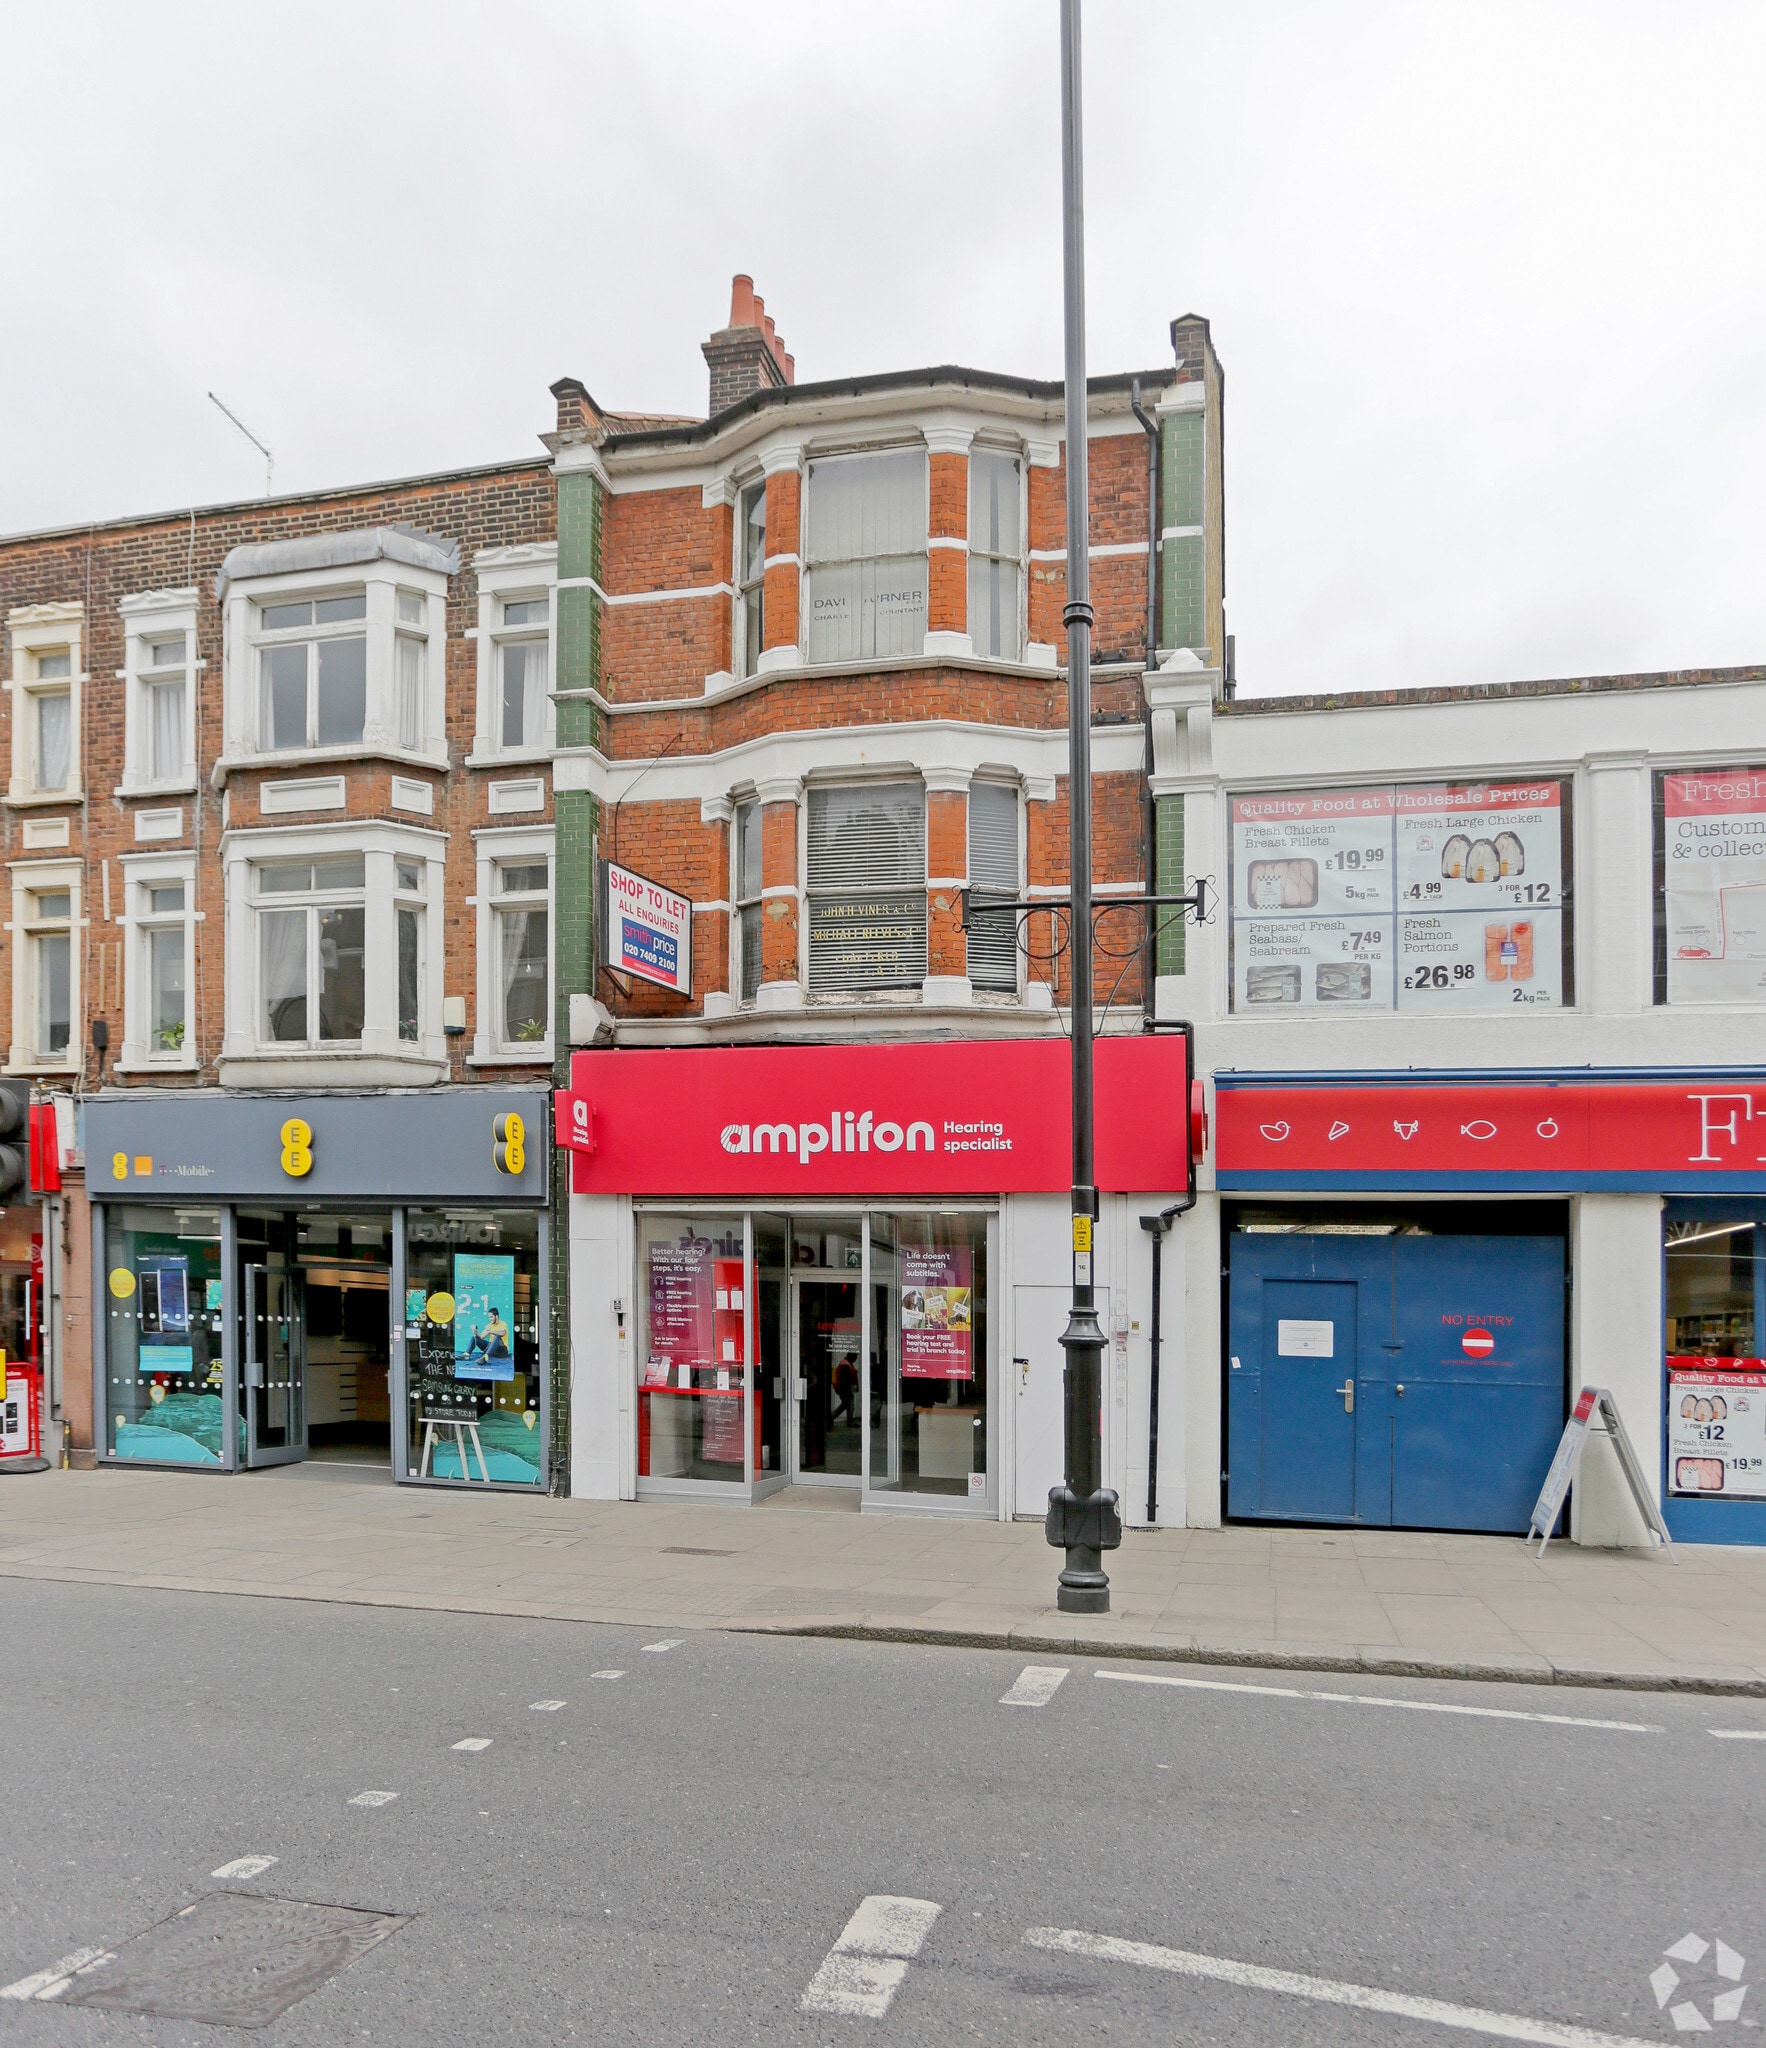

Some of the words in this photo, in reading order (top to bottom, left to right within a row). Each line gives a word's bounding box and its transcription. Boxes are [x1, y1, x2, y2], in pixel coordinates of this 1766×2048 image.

[1239, 801, 1306, 817] Quality
[1311, 798, 1356, 812] Food
[1361, 798, 1381, 809] at
[1386, 791, 1483, 809] Wholesale
[1488, 788, 1550, 803] Prices
[1404, 817, 1443, 830] Fresh
[1446, 816, 1484, 829] Large
[1488, 813, 1543, 826] Chicken
[1245, 827, 1281, 837] Fresh
[1284, 824, 1336, 836] Chicken
[1245, 838, 1287, 849] Breast
[1289, 836, 1330, 847] Fillets
[1672, 843, 1692, 859] &
[1698, 840, 1766, 858] collec
[1325, 848, 1384, 870] £19.99
[611, 871, 644, 899] SHOP
[647, 887, 663, 909] TO
[666, 896, 687, 920] LET
[1514, 883, 1551, 903] £12
[618, 899, 634, 915] ALL
[636, 907, 680, 935] ENQUIRIES
[1404, 917, 1441, 929] Fresh
[1249, 921, 1307, 934] Prepared
[1309, 920, 1346, 931] Fresh
[1249, 933, 1304, 945] Seabass/
[1404, 930, 1453, 941] Salmon
[1249, 945, 1311, 957] Seabream
[1404, 942, 1459, 953] Portions
[624, 943, 639, 956] 020
[640, 949, 657, 963] 7409
[658, 956, 676, 971] 2100
[1404, 964, 1475, 989] £26.98
[943, 1121, 1003, 1136] Hearing
[1687, 1093, 1766, 1162] F
[720, 1110, 935, 1164] amplifon
[943, 1138, 1013, 1153] specialist
[675, 1248, 706, 1257] hearing?
[906, 1252, 921, 1260] Life
[922, 1252, 951, 1260] doesn't
[652, 1265, 672, 1273] steps,
[684, 1265, 702, 1273] easy.
[929, 1261, 946, 1269] with
[906, 1269, 940, 1278] subtitles.
[1441, 1314, 1463, 1326] NO
[1466, 1314, 1514, 1326] ENTRY
[906, 1340, 929, 1348] hearing
[948, 1348, 967, 1356] today.
[1674, 1372, 1715, 1384] Quality
[1717, 1373, 1744, 1384] Food
[1746, 1375, 1759, 1384] at
[1700, 1386, 1725, 1394] Large
[1725, 1387, 1760, 1395] Chicken
[1699, 1425, 1725, 1440] £12
[1699, 1440, 1733, 1448] Chicken
[1673, 1447, 1701, 1455] Breast
[1702, 1448, 1728, 1456] Fillets
